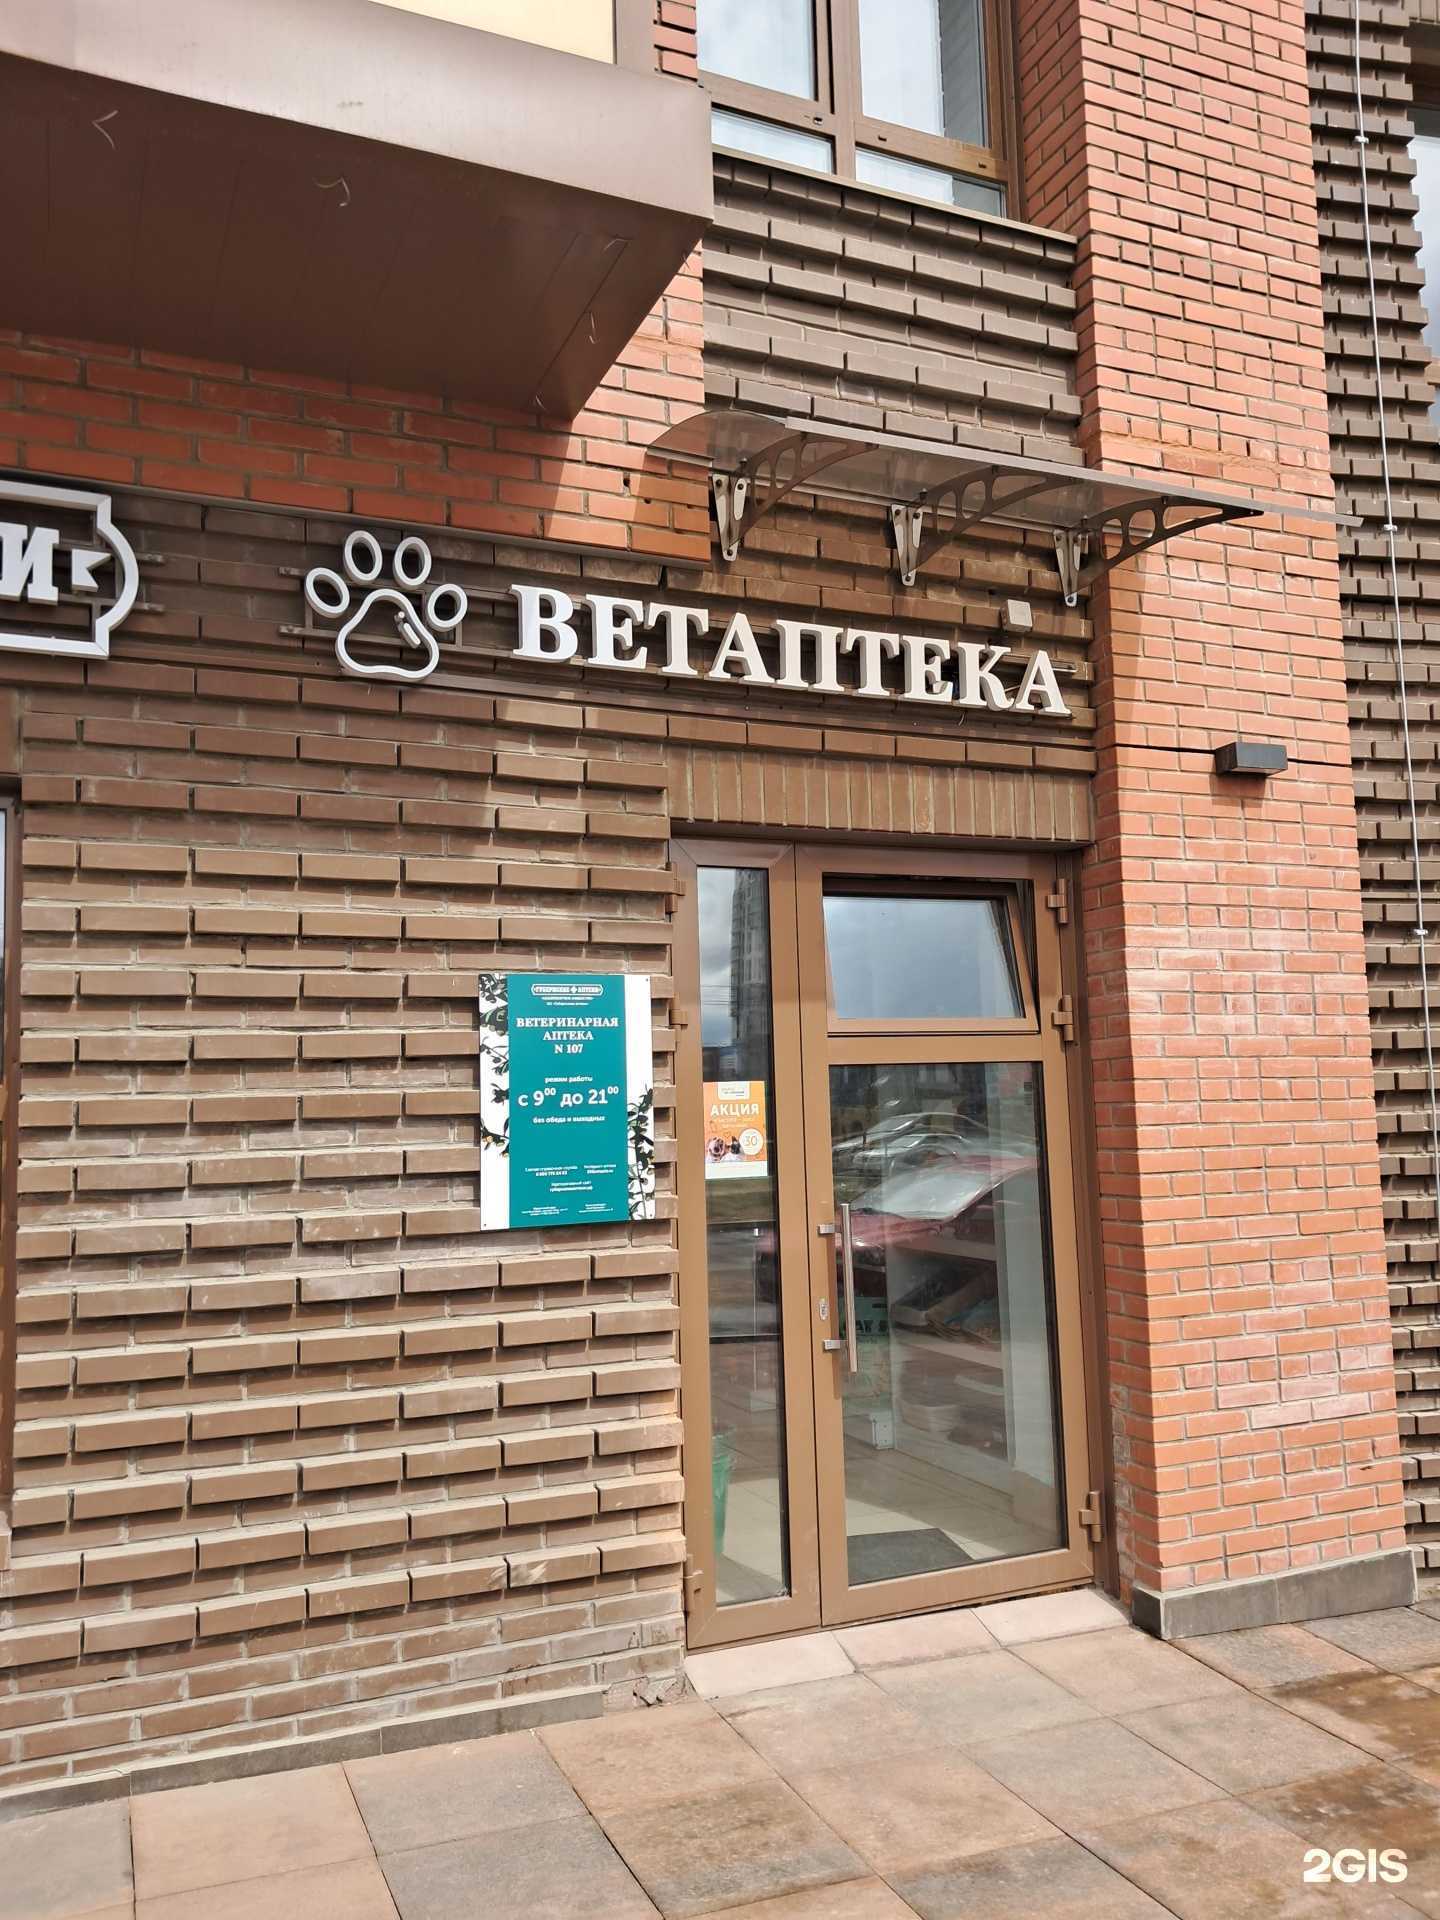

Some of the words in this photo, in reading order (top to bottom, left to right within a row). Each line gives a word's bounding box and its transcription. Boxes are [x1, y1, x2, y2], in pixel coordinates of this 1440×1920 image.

[509, 584, 1073, 717] ВЕТАПТЕКА
[516, 1017, 619, 1028] ВЕТЕРИНАРНАЯ
[543, 1030, 594, 1041] АПТЕКА
[554, 1044, 563, 1054] N
[566, 1043, 583, 1054] 107
[569, 1075, 593, 1083] работы
[518, 1094, 529, 1106] с
[560, 1092, 583, 1108] до
[710, 1103, 759, 1117] АКЦИЯ
